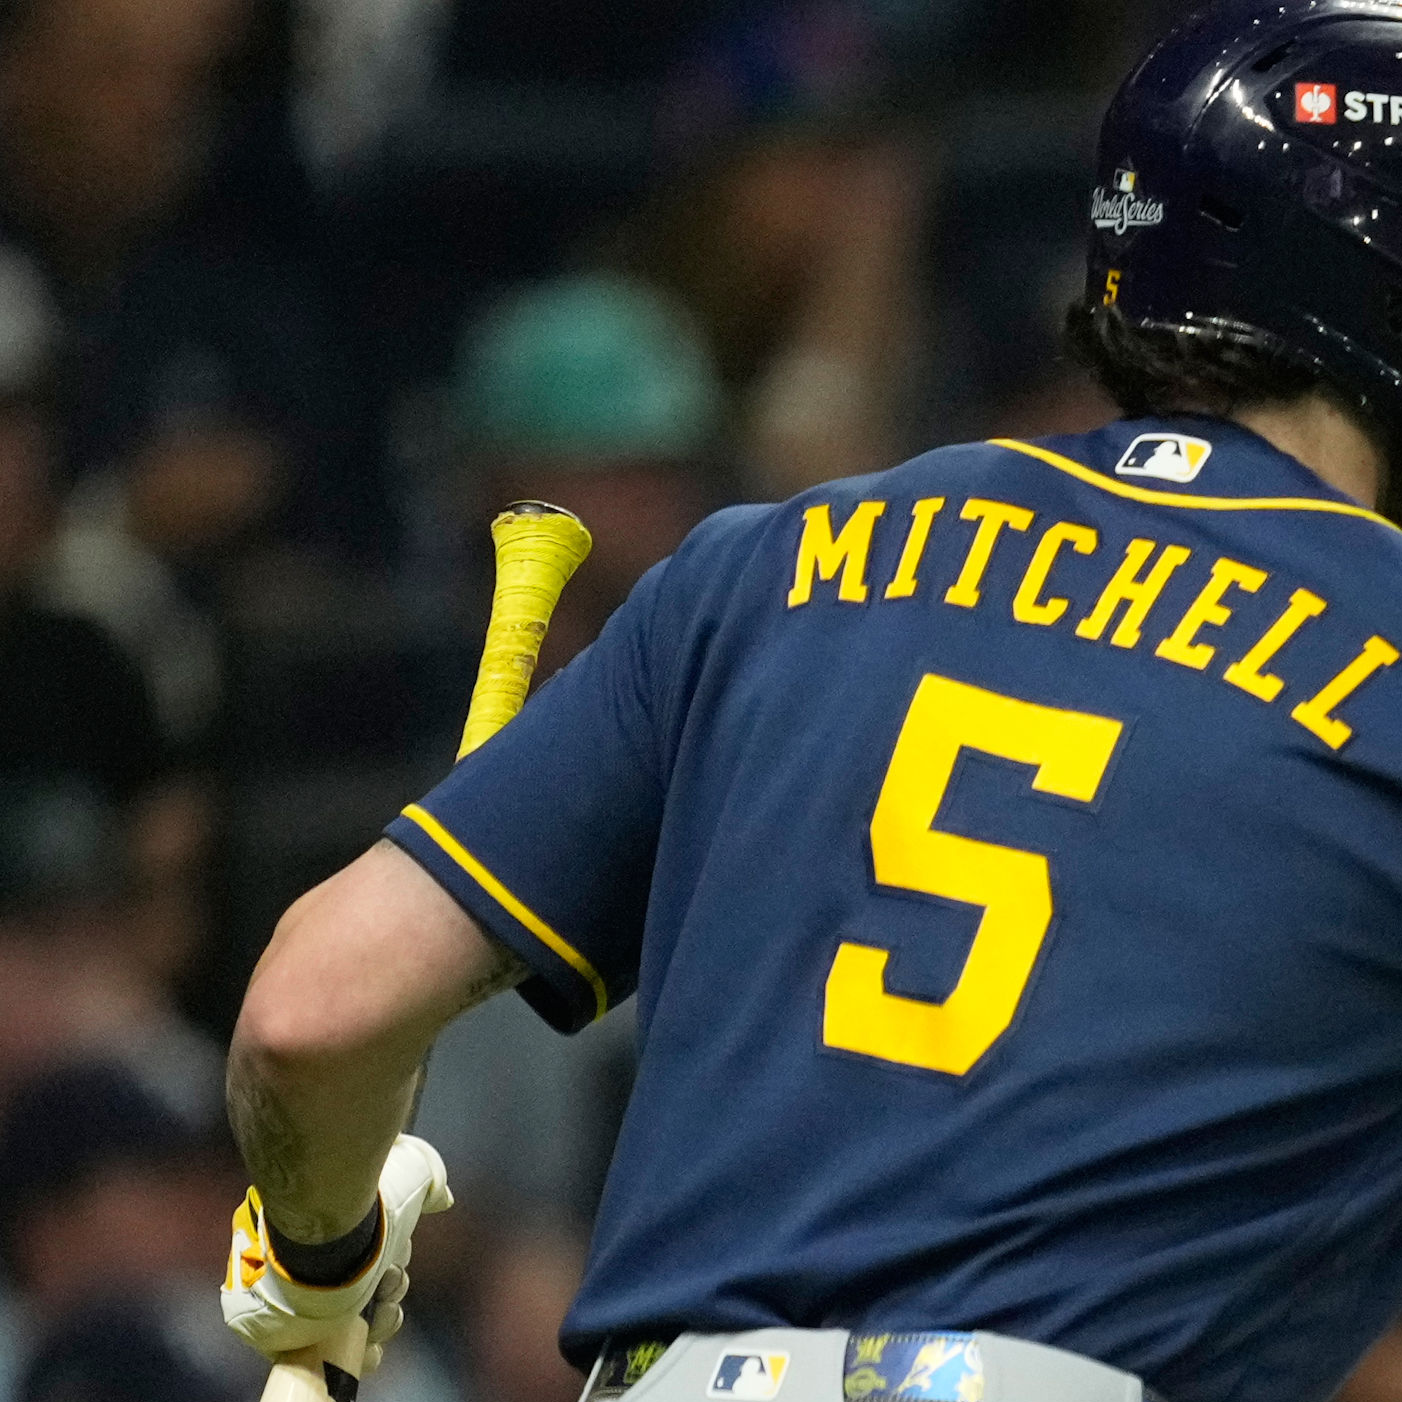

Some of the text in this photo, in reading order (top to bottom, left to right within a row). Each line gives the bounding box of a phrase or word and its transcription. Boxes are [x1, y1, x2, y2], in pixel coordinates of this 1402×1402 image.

[1091, 186, 1164, 236] World Series
[1103, 268, 1121, 306] 5
[788, 496, 1400, 750] MITCHELL
[822, 672, 1123, 1076] 5
